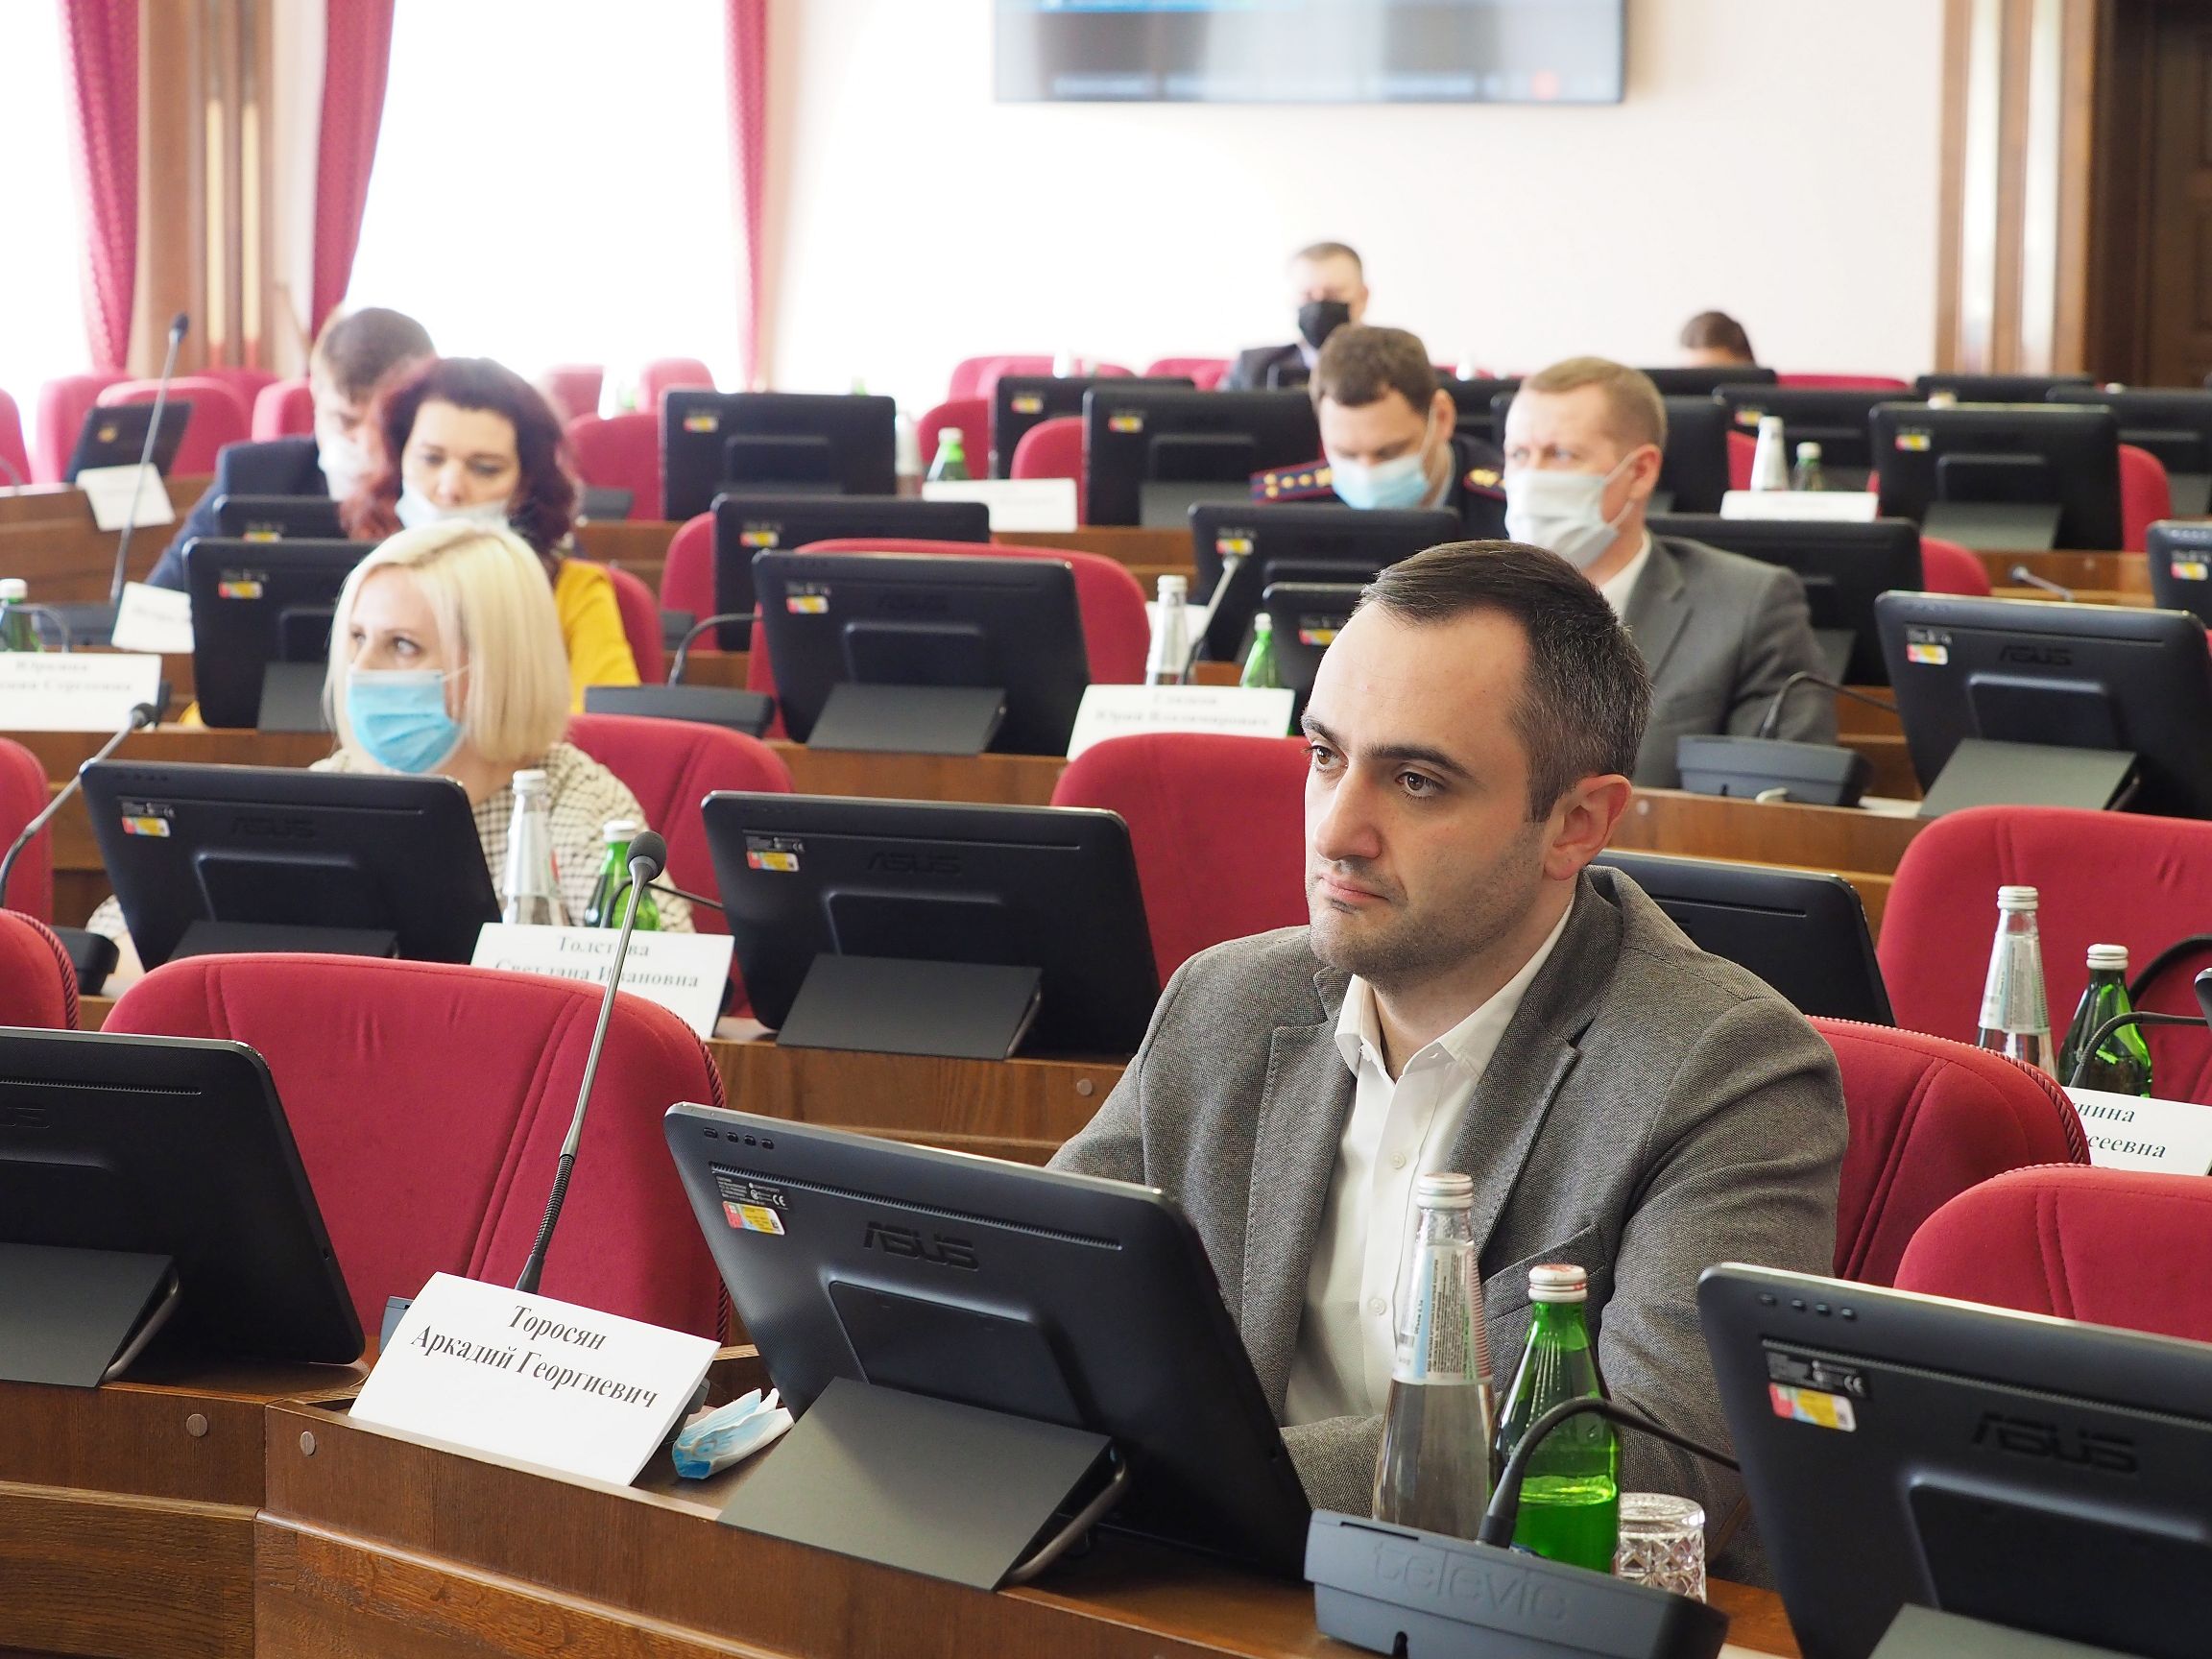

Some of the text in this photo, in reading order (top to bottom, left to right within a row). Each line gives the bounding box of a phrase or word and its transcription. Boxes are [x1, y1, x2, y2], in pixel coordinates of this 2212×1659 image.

[1999, 645, 2073, 666] ASUS
[867, 852, 961, 875] ASUS
[557, 935, 650, 956] Толства
[597, 966, 699, 988] Иановна
[2072, 1102, 2135, 1123] нина
[863, 1220, 979, 1272] ASUS
[506, 1305, 608, 1351] Торосян
[410, 1325, 659, 1409] Аркадий Георгиевич
[1971, 1411, 2137, 1474] ASUS
